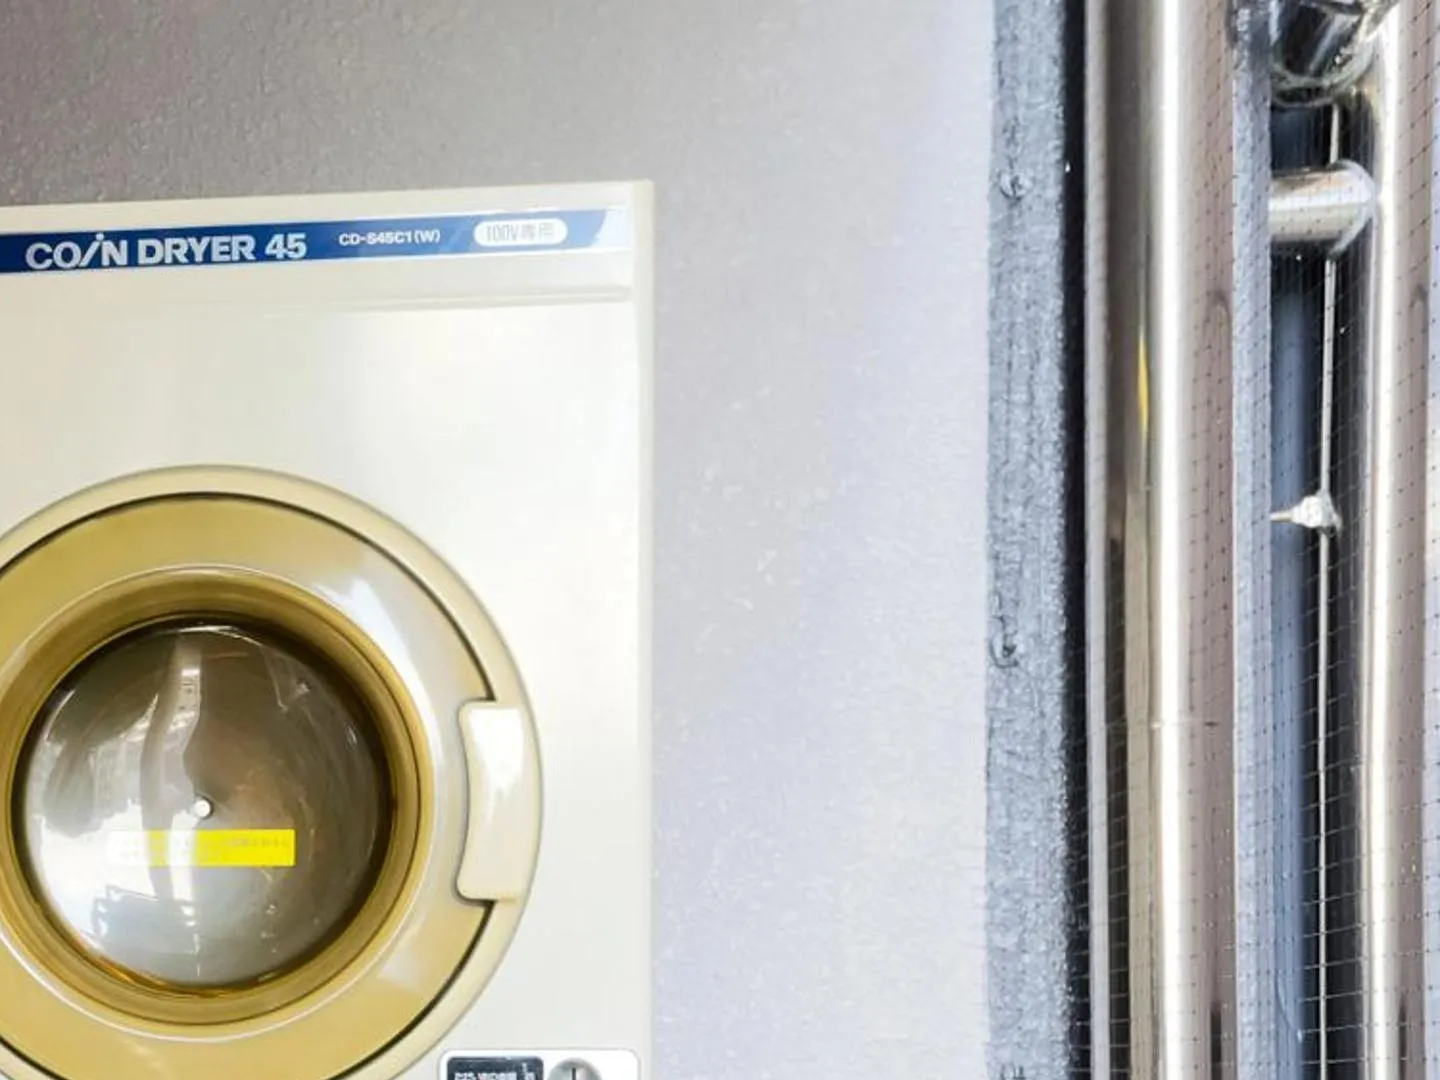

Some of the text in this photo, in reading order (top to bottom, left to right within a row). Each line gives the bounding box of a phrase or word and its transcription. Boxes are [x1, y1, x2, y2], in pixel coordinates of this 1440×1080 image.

[25, 232, 308, 270] COIN DRYER 45
